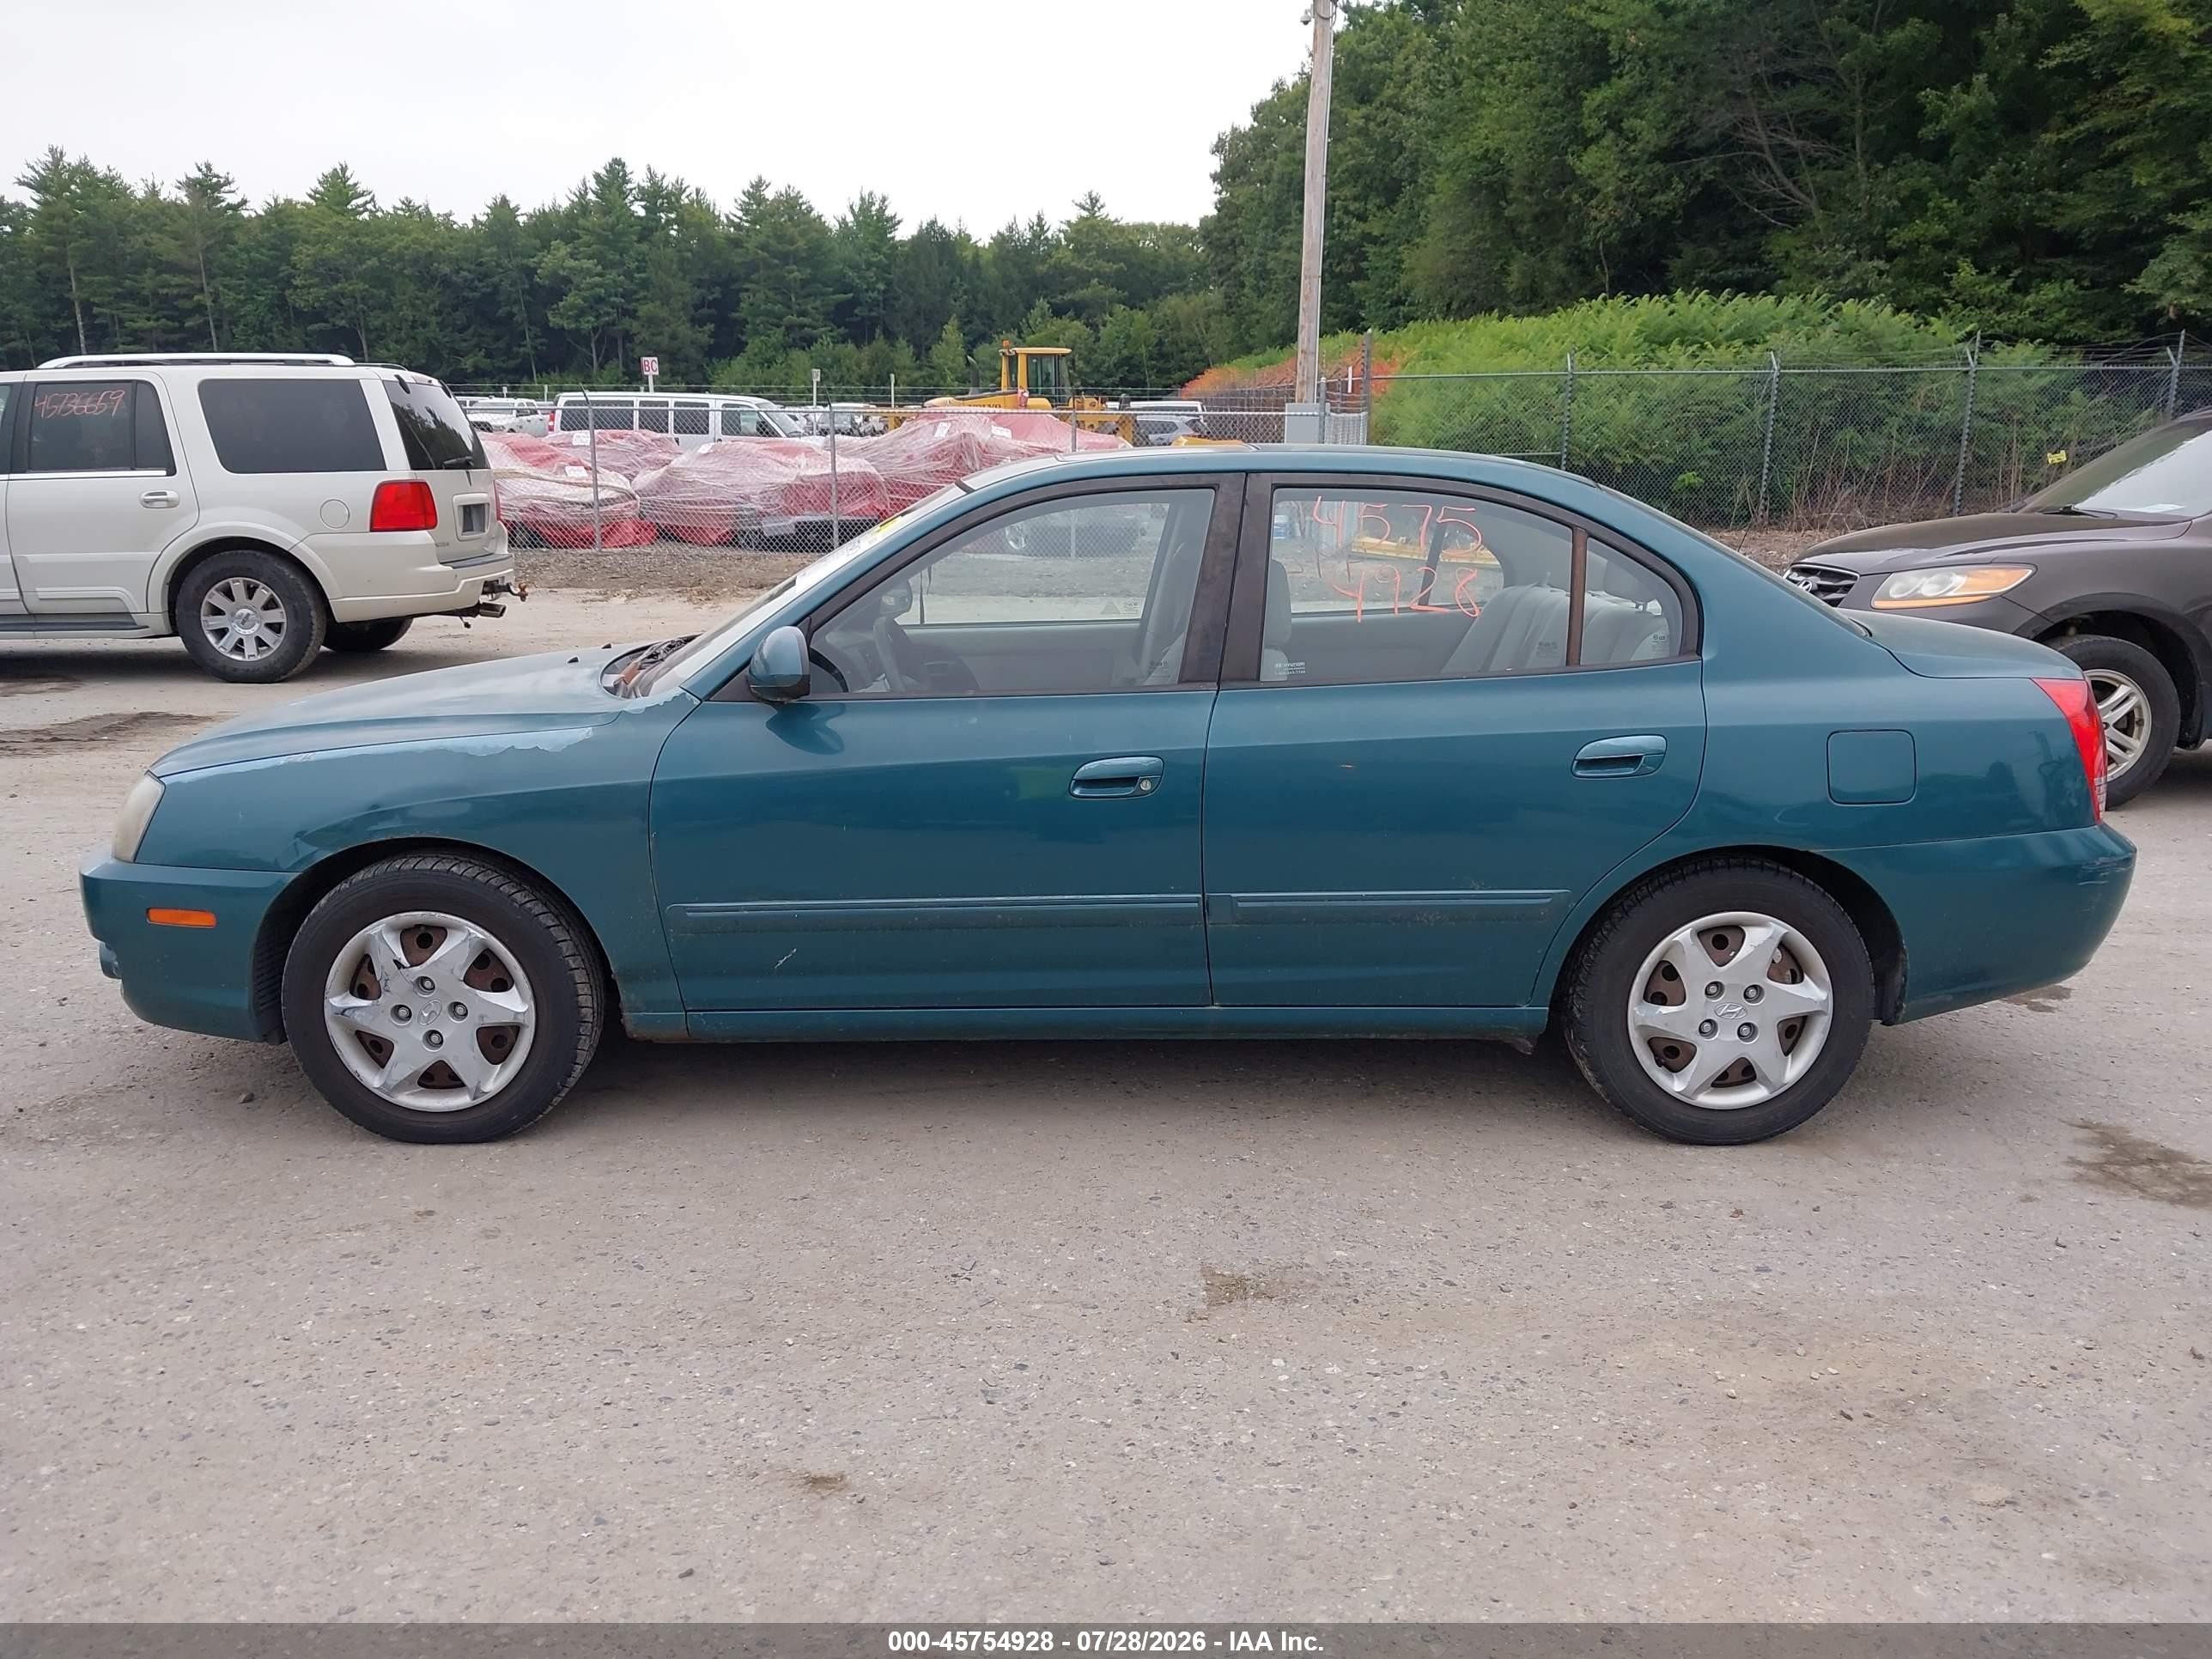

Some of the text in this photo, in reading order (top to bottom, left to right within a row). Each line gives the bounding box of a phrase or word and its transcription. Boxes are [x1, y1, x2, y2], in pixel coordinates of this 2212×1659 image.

[644, 359, 658, 373] BC
[1313, 495, 1482, 555] 4575
[1331, 564, 1482, 623] 4928
